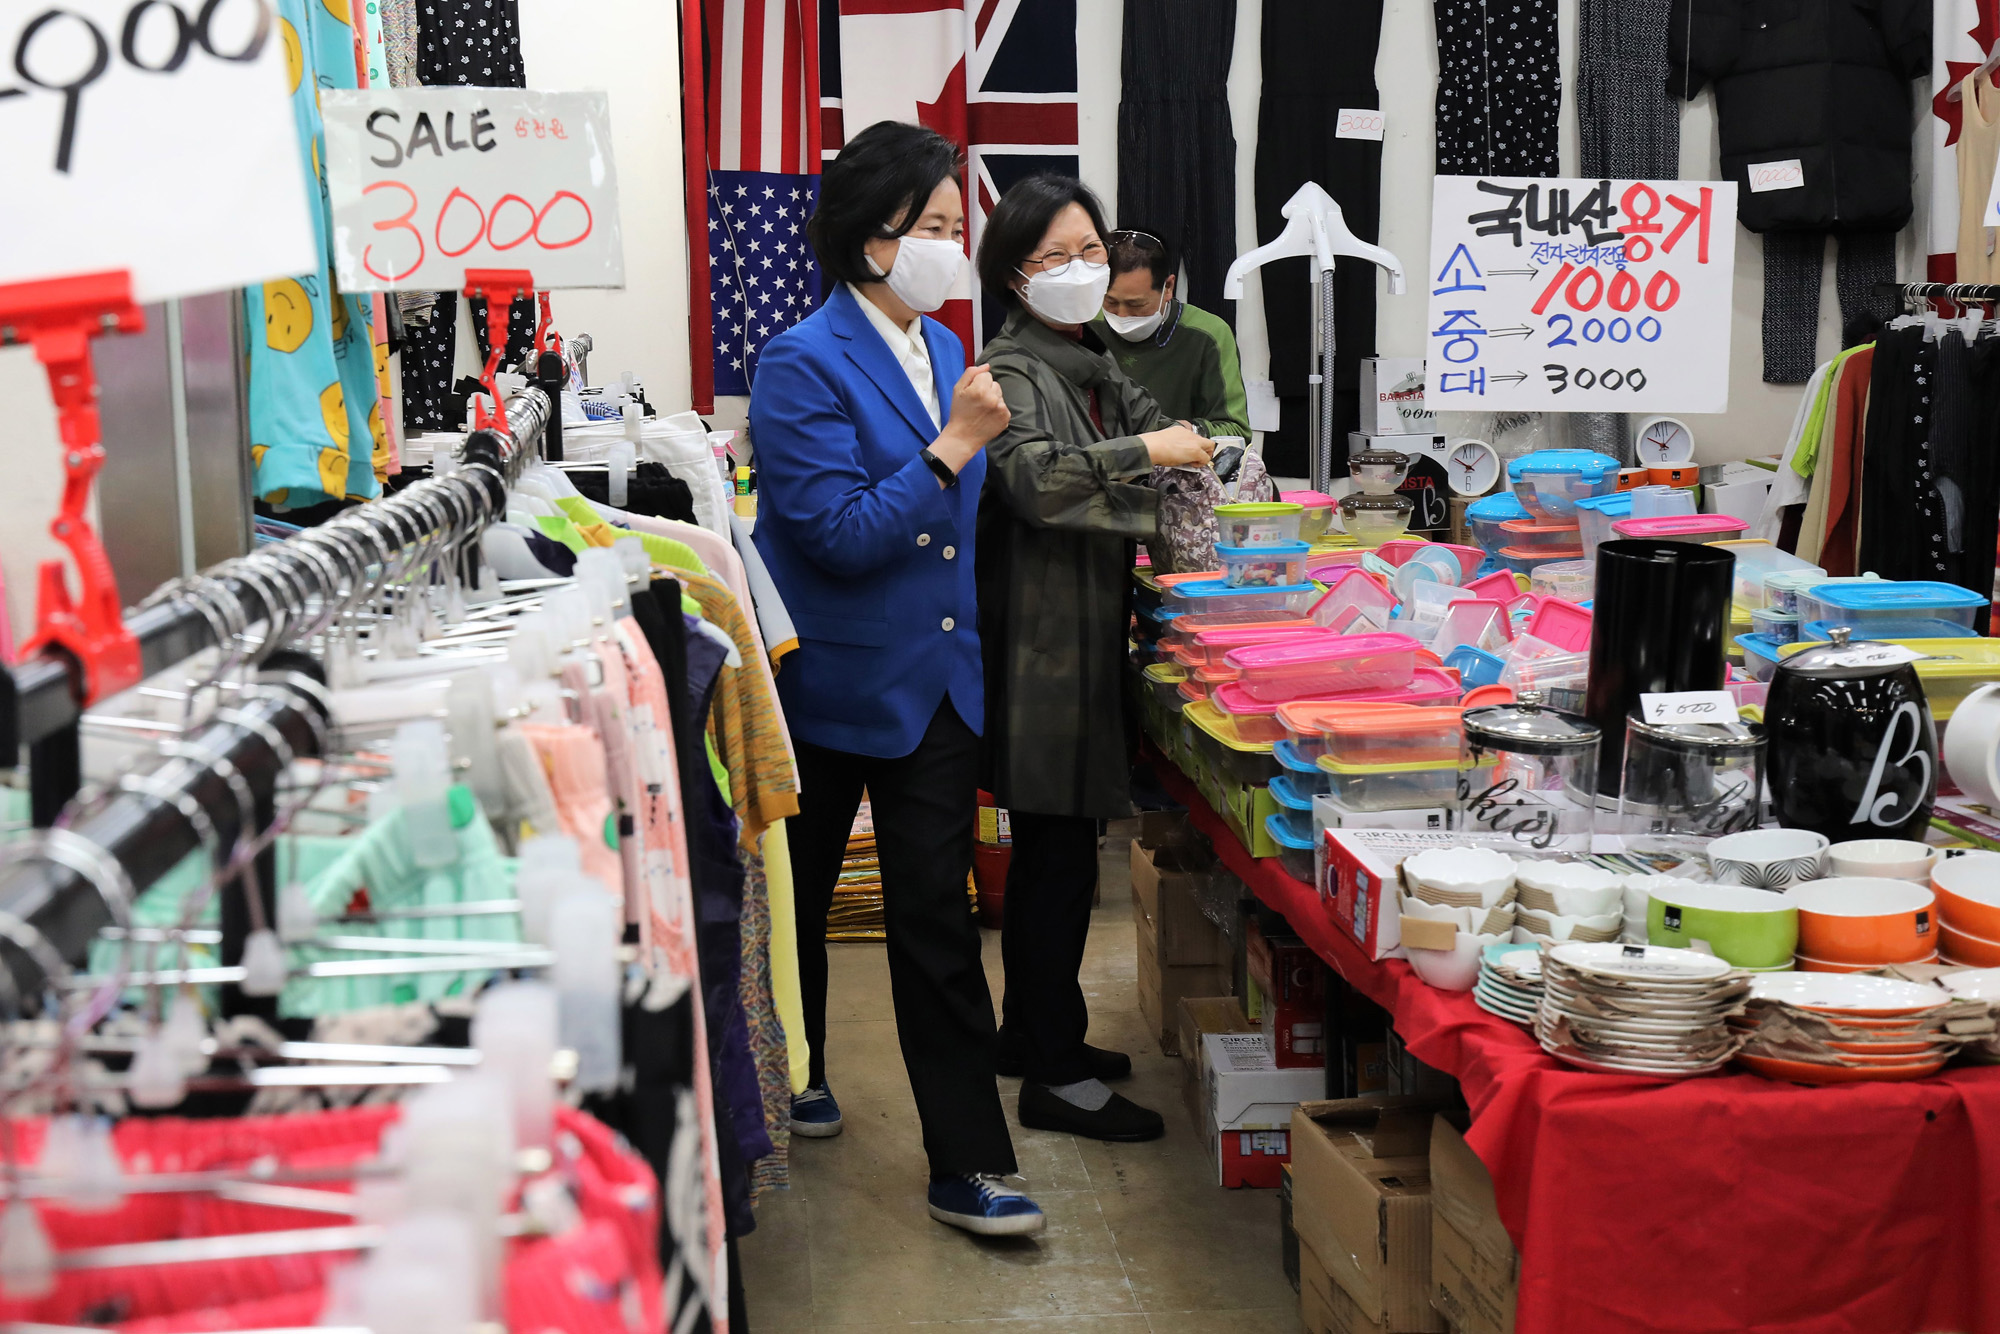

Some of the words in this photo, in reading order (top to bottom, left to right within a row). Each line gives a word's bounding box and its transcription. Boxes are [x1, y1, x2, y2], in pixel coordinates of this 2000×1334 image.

[366, 107, 497, 168] SALE
[1340, 115, 1382, 132] 3000
[362, 180, 593, 281] 3000
[1432, 243, 1487, 296] 소
[1531, 262, 1681, 316] 1000
[1432, 310, 1488, 363] 중
[1547, 314, 1662, 348] 2000
[1379, 391, 1425, 401] BARISTA
[1440, 367, 1485, 396] 대
[1543, 364, 1648, 394] 3000
